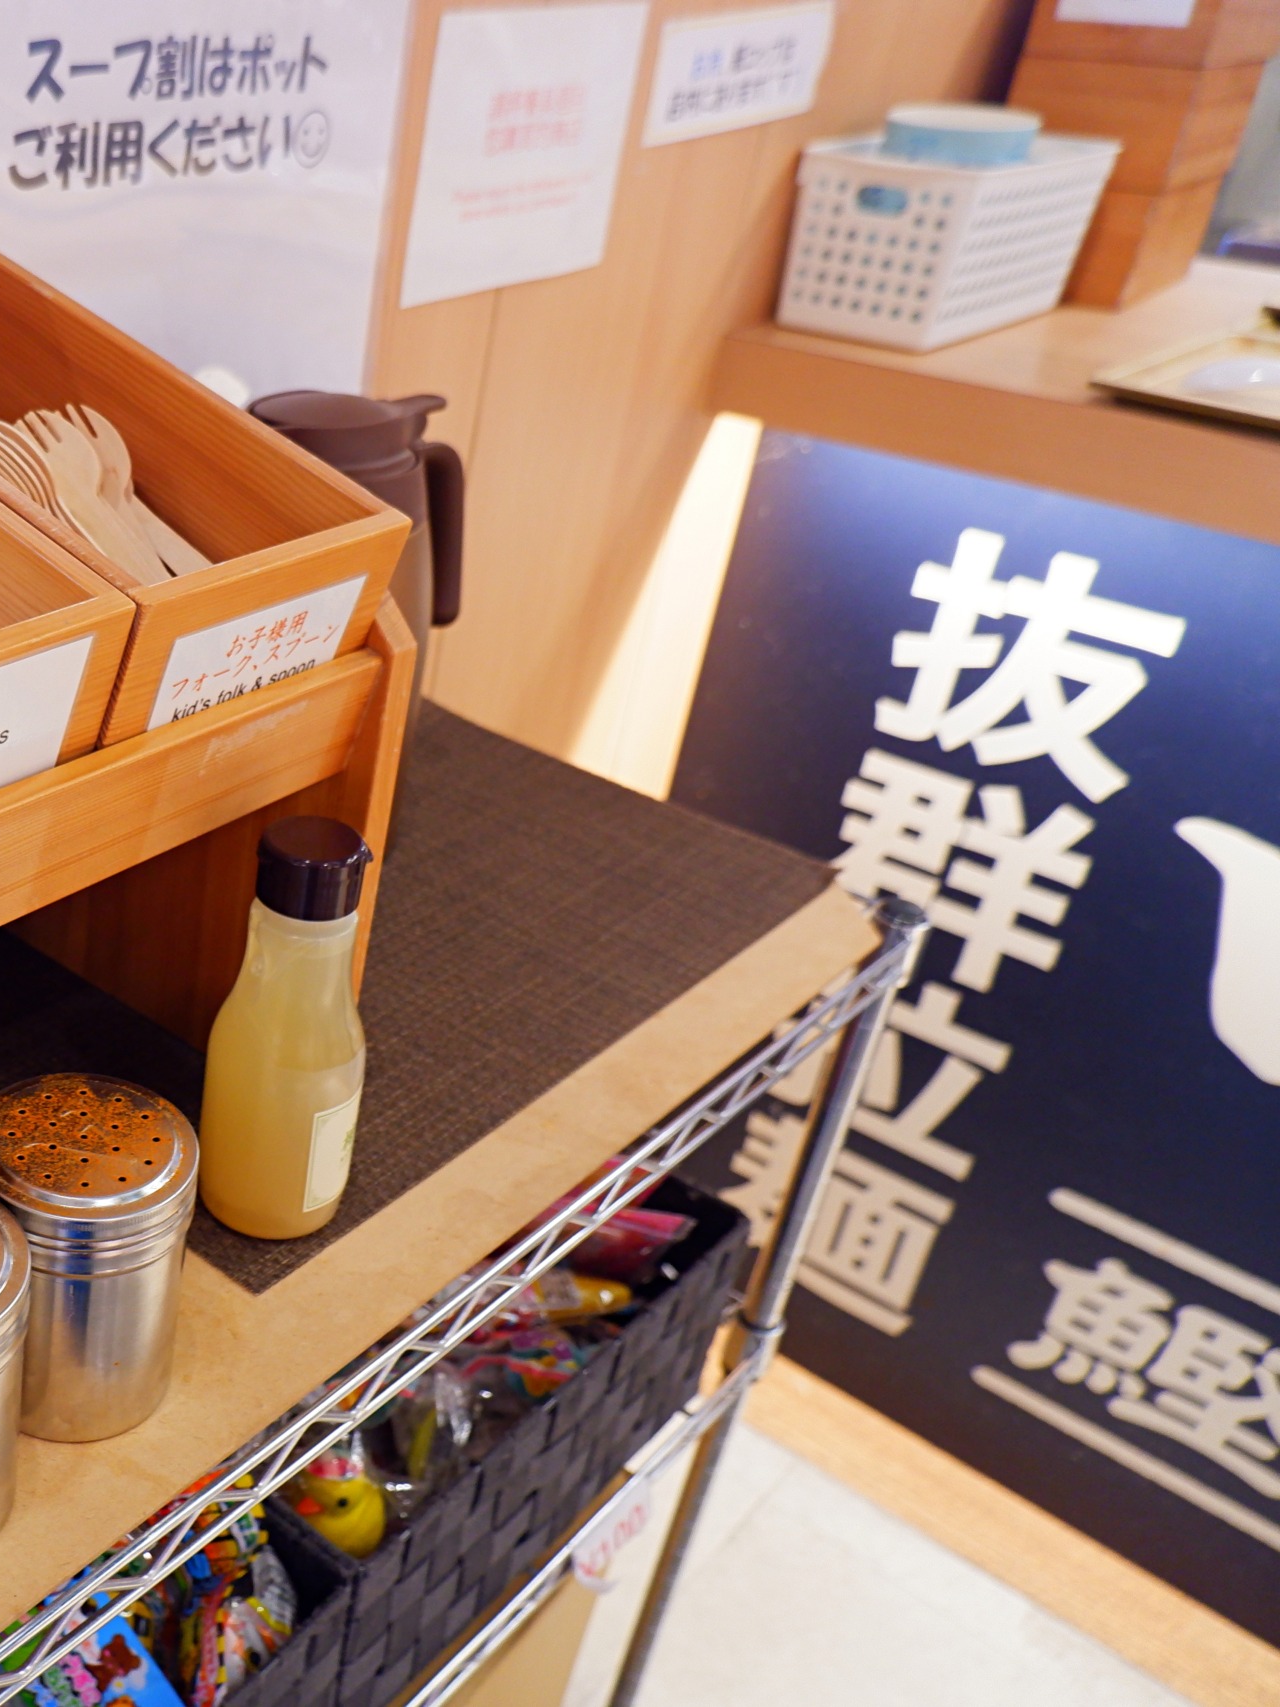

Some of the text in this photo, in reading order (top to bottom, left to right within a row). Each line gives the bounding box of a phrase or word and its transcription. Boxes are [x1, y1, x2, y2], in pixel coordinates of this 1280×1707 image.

[26, 34, 327, 102] スープ割はポット
[9, 114, 291, 191] ご利用ください
[172, 624, 340, 699] フォーク、スプーン
[226, 610, 309, 657] お子様用
[171, 659, 315, 722] kid's folk & spoon
